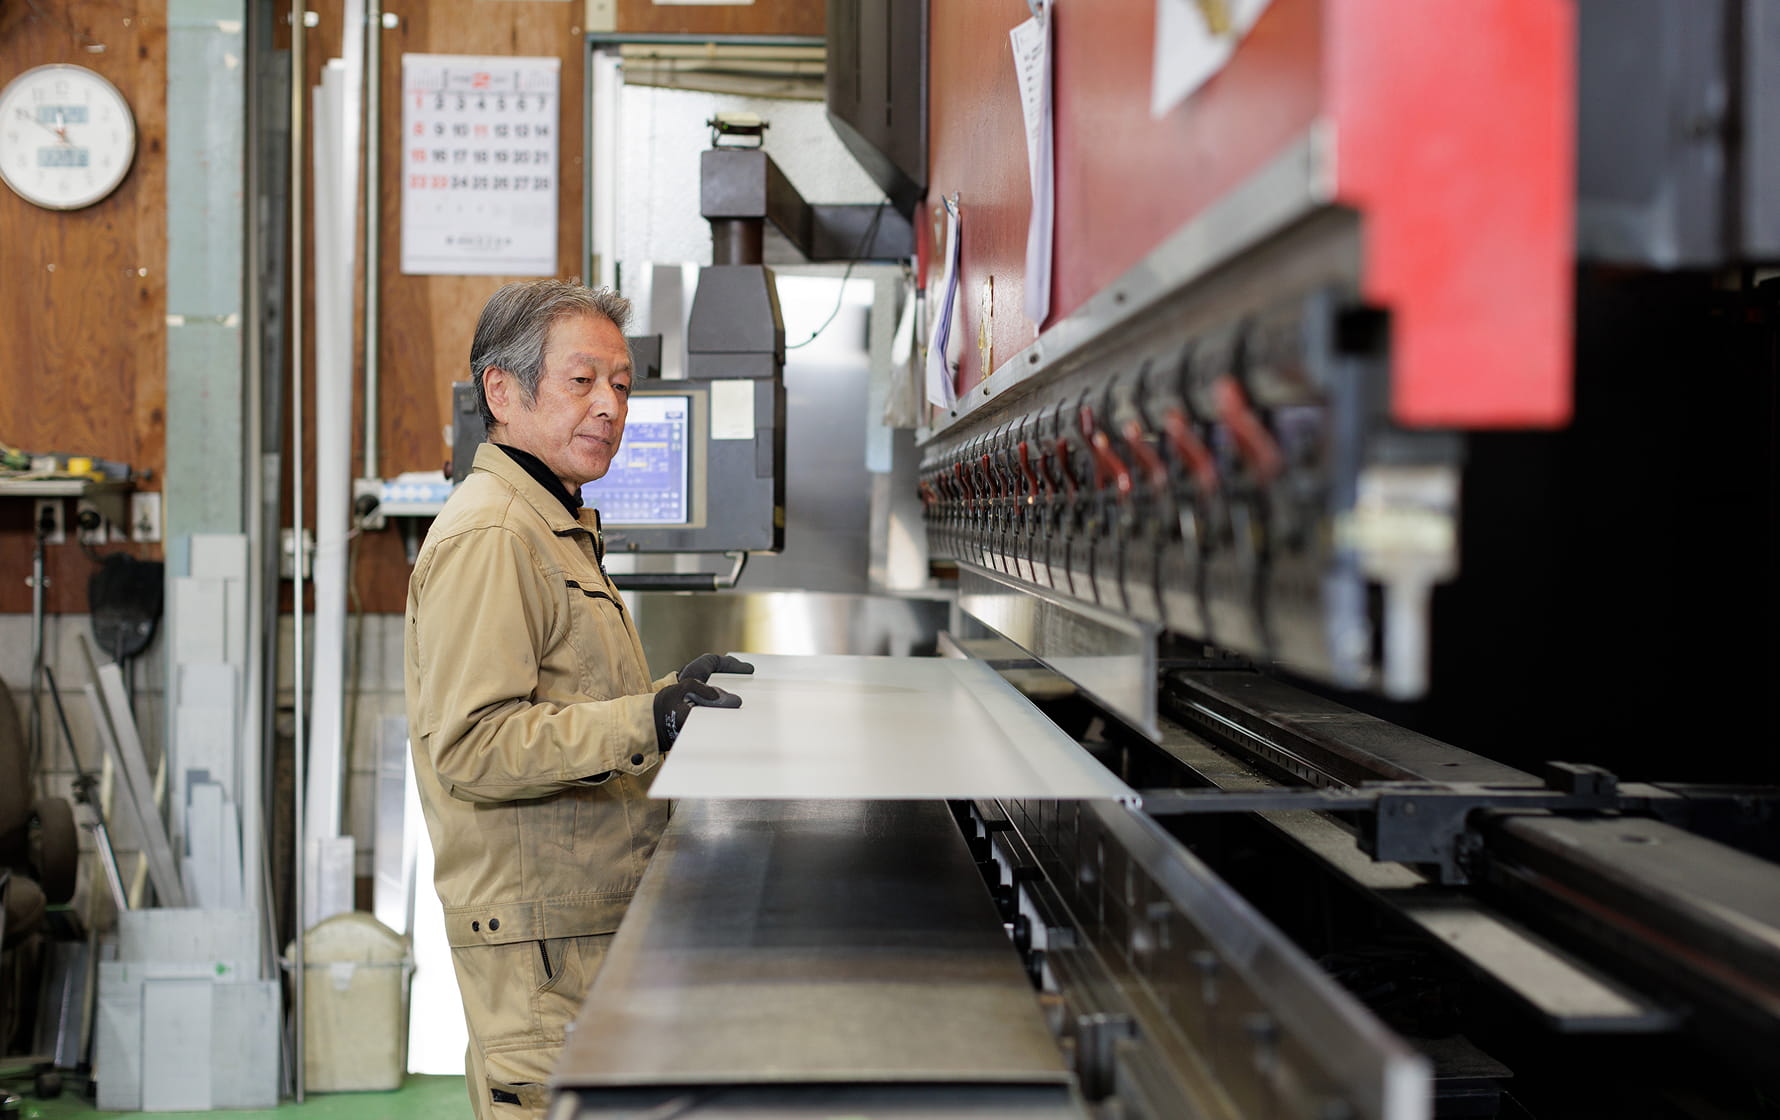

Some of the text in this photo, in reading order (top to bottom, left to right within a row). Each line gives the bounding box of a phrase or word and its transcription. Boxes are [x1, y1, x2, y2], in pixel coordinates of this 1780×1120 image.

[415, 95, 546, 110] 1 2 3 4 5 6 7
[413, 122, 550, 137] 8 9 10 11 12 13 14
[432, 149, 447, 164] 16
[453, 149, 468, 164] 17
[473, 149, 489, 164] 18
[494, 149, 509, 164] 19
[513, 149, 529, 164] 20
[533, 149, 550, 164] 21
[410, 175, 427, 190] 22
[451, 175, 469, 190] 24
[472, 175, 489, 190] 25
[493, 175, 509, 190] 26
[513, 175, 530, 190] 27
[533, 175, 551, 190] 28
